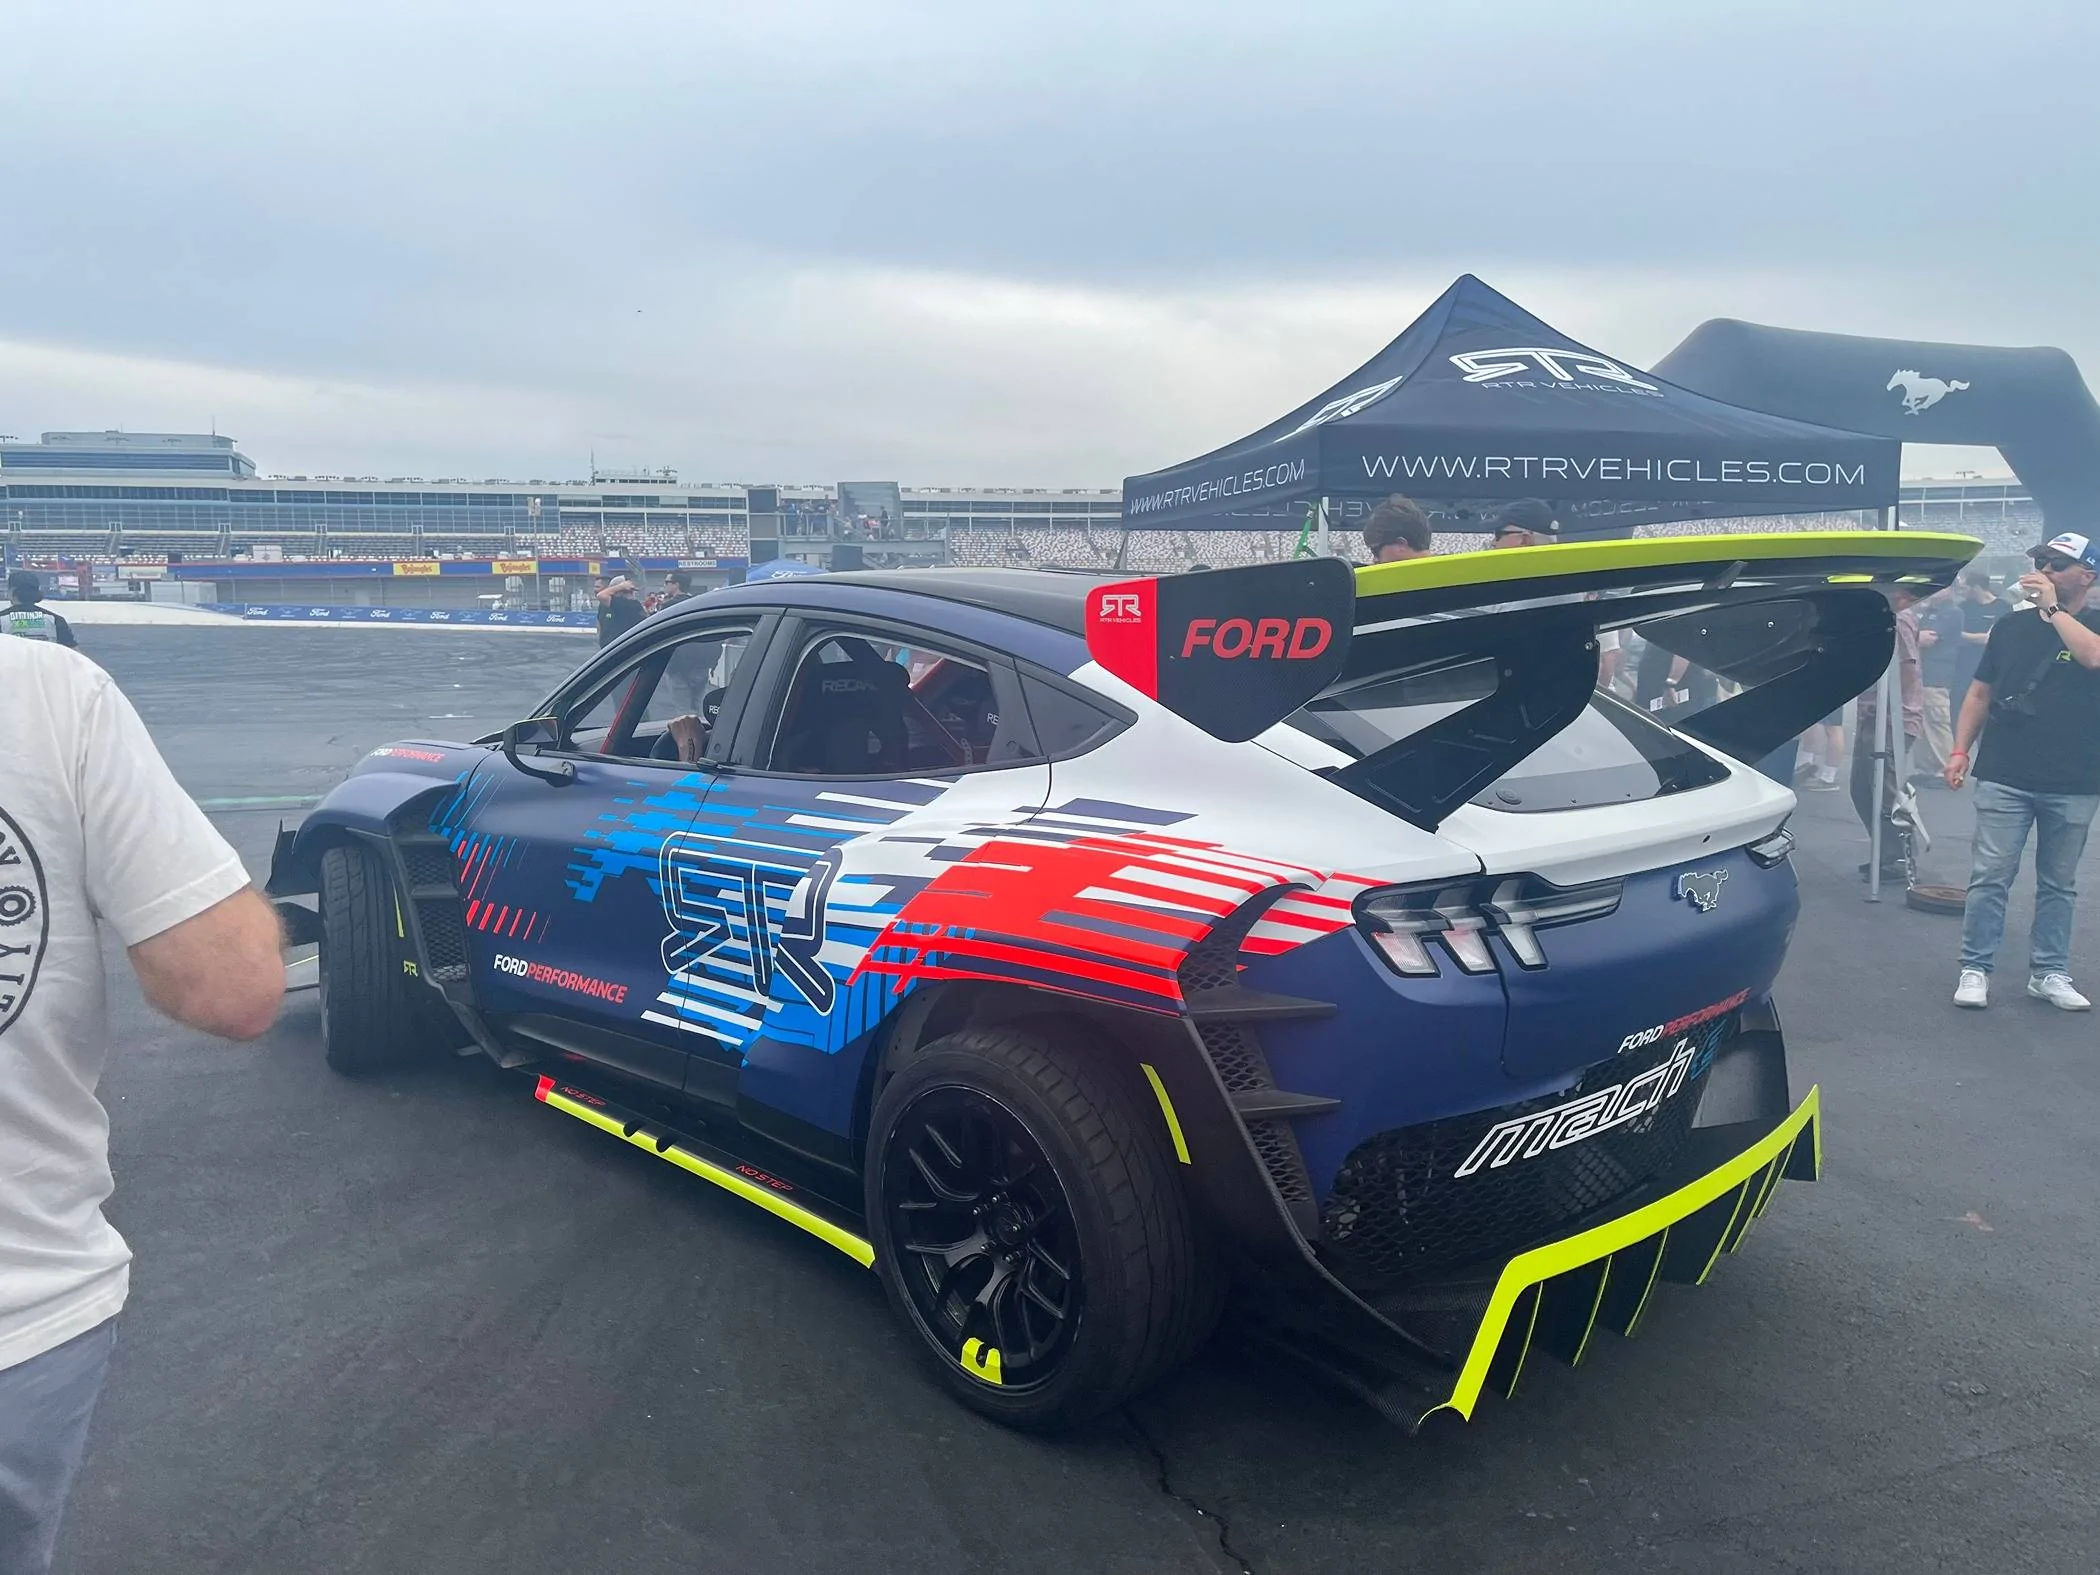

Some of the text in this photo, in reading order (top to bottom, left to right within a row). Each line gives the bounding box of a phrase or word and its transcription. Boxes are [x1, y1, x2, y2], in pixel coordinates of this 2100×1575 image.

[1481, 381, 1665, 398] RTR VEHICLES
[1362, 455, 1865, 485] WWW.RTRVEHICLES.COM
[1129, 458, 1305, 515] WWW.RTRVEHICLES.COM
[246, 607, 270, 616] Ford
[309, 607, 330, 617] Ford
[370, 609, 391, 618] Ford
[430, 611, 450, 620] Ford
[488, 612, 509, 621] Ford
[546, 614, 566, 623] Ford
[1180, 617, 1333, 660] FORD
[575, 1090, 607, 1105] STEP
[735, 1165, 793, 1190] NO STEP
